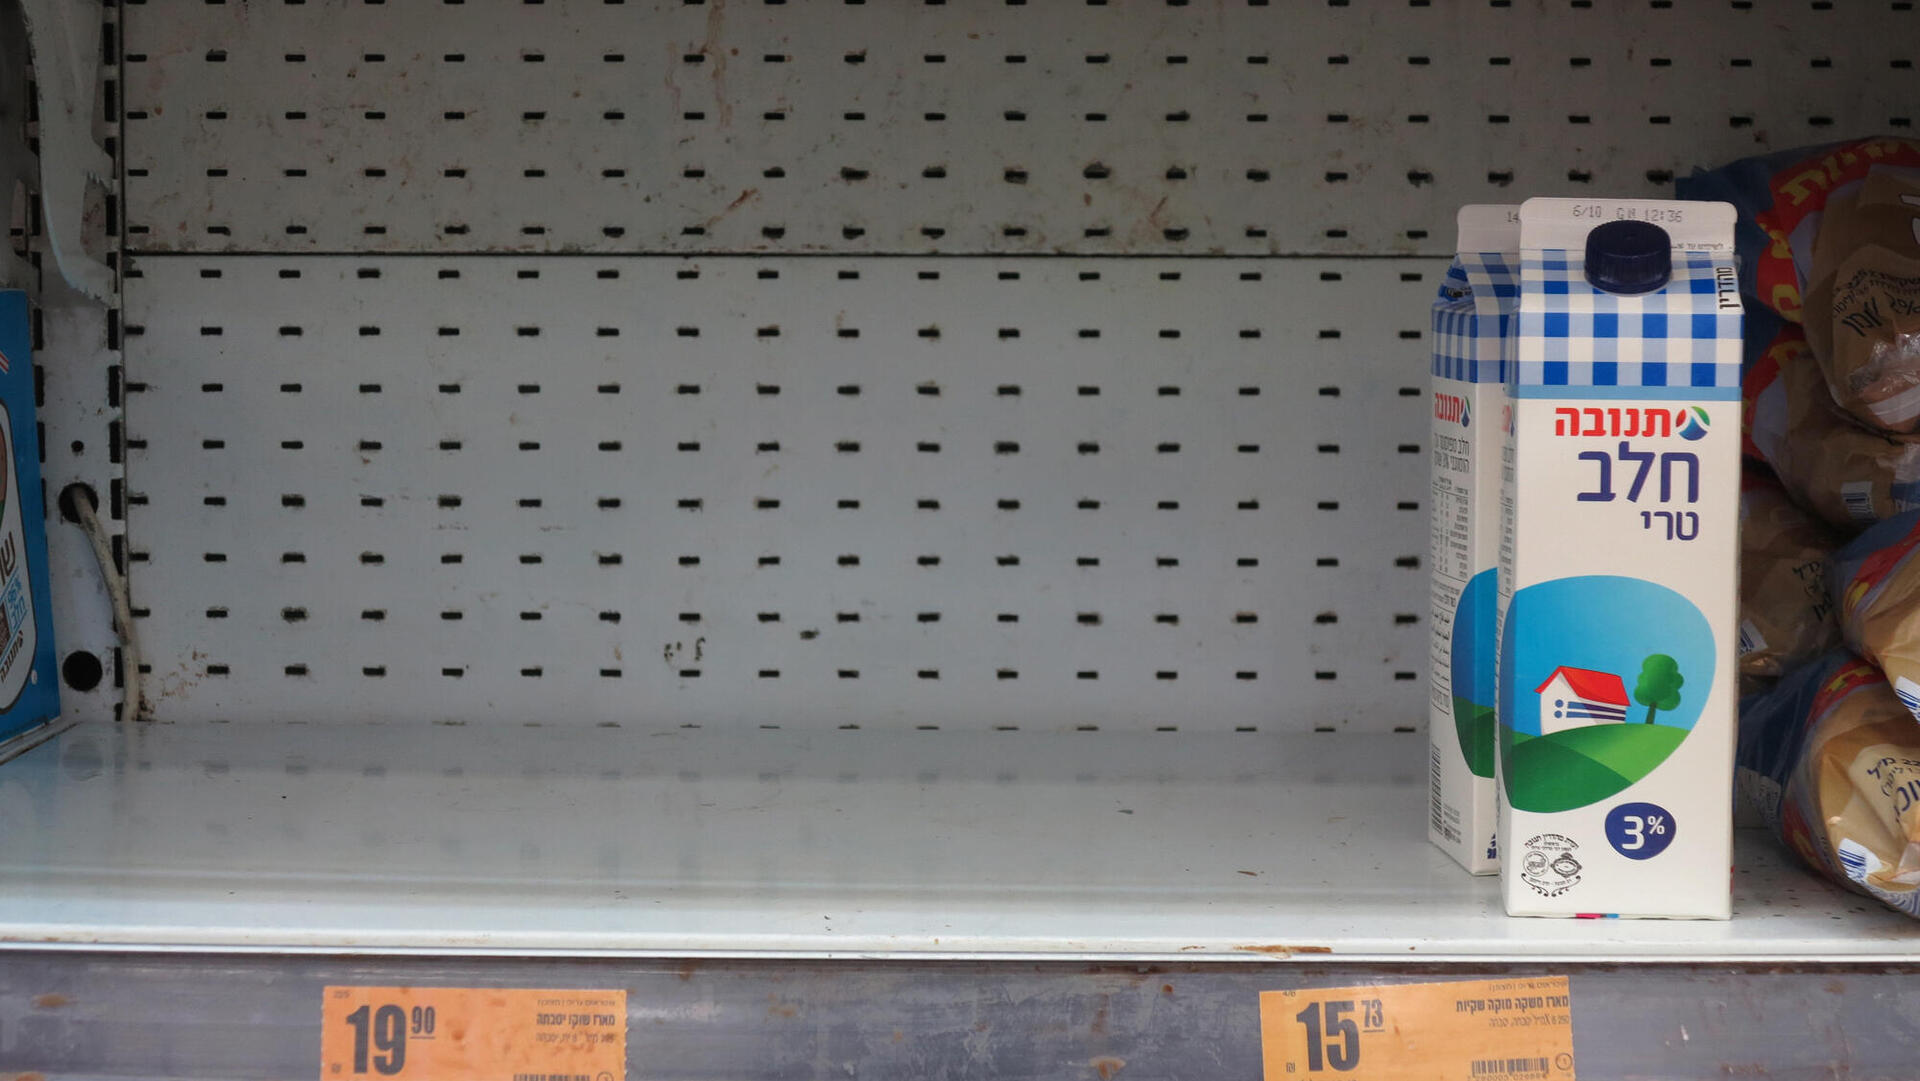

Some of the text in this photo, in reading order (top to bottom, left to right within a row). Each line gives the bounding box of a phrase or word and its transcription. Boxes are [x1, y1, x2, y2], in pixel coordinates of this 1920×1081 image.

[1573, 205, 1602, 219] 6/10
[1645, 209, 1682, 223] 12:36
[1716, 267, 1740, 310] מהדרין
[1435, 392, 1460, 424] תנובה
[1555, 407, 1671, 438] תנובה
[1577, 441, 1700, 503] חלב
[1640, 511, 1699, 540] טרי
[1621, 815, 1666, 851] 3%
[593, 1014, 615, 1025] מארז
[1456, 995, 1569, 1016] מארז משקה מוקה שקיות
[568, 1014, 590, 1029] שוקו
[1296, 999, 1384, 1072] 15 73
[346, 1004, 436, 1076] 19 90
